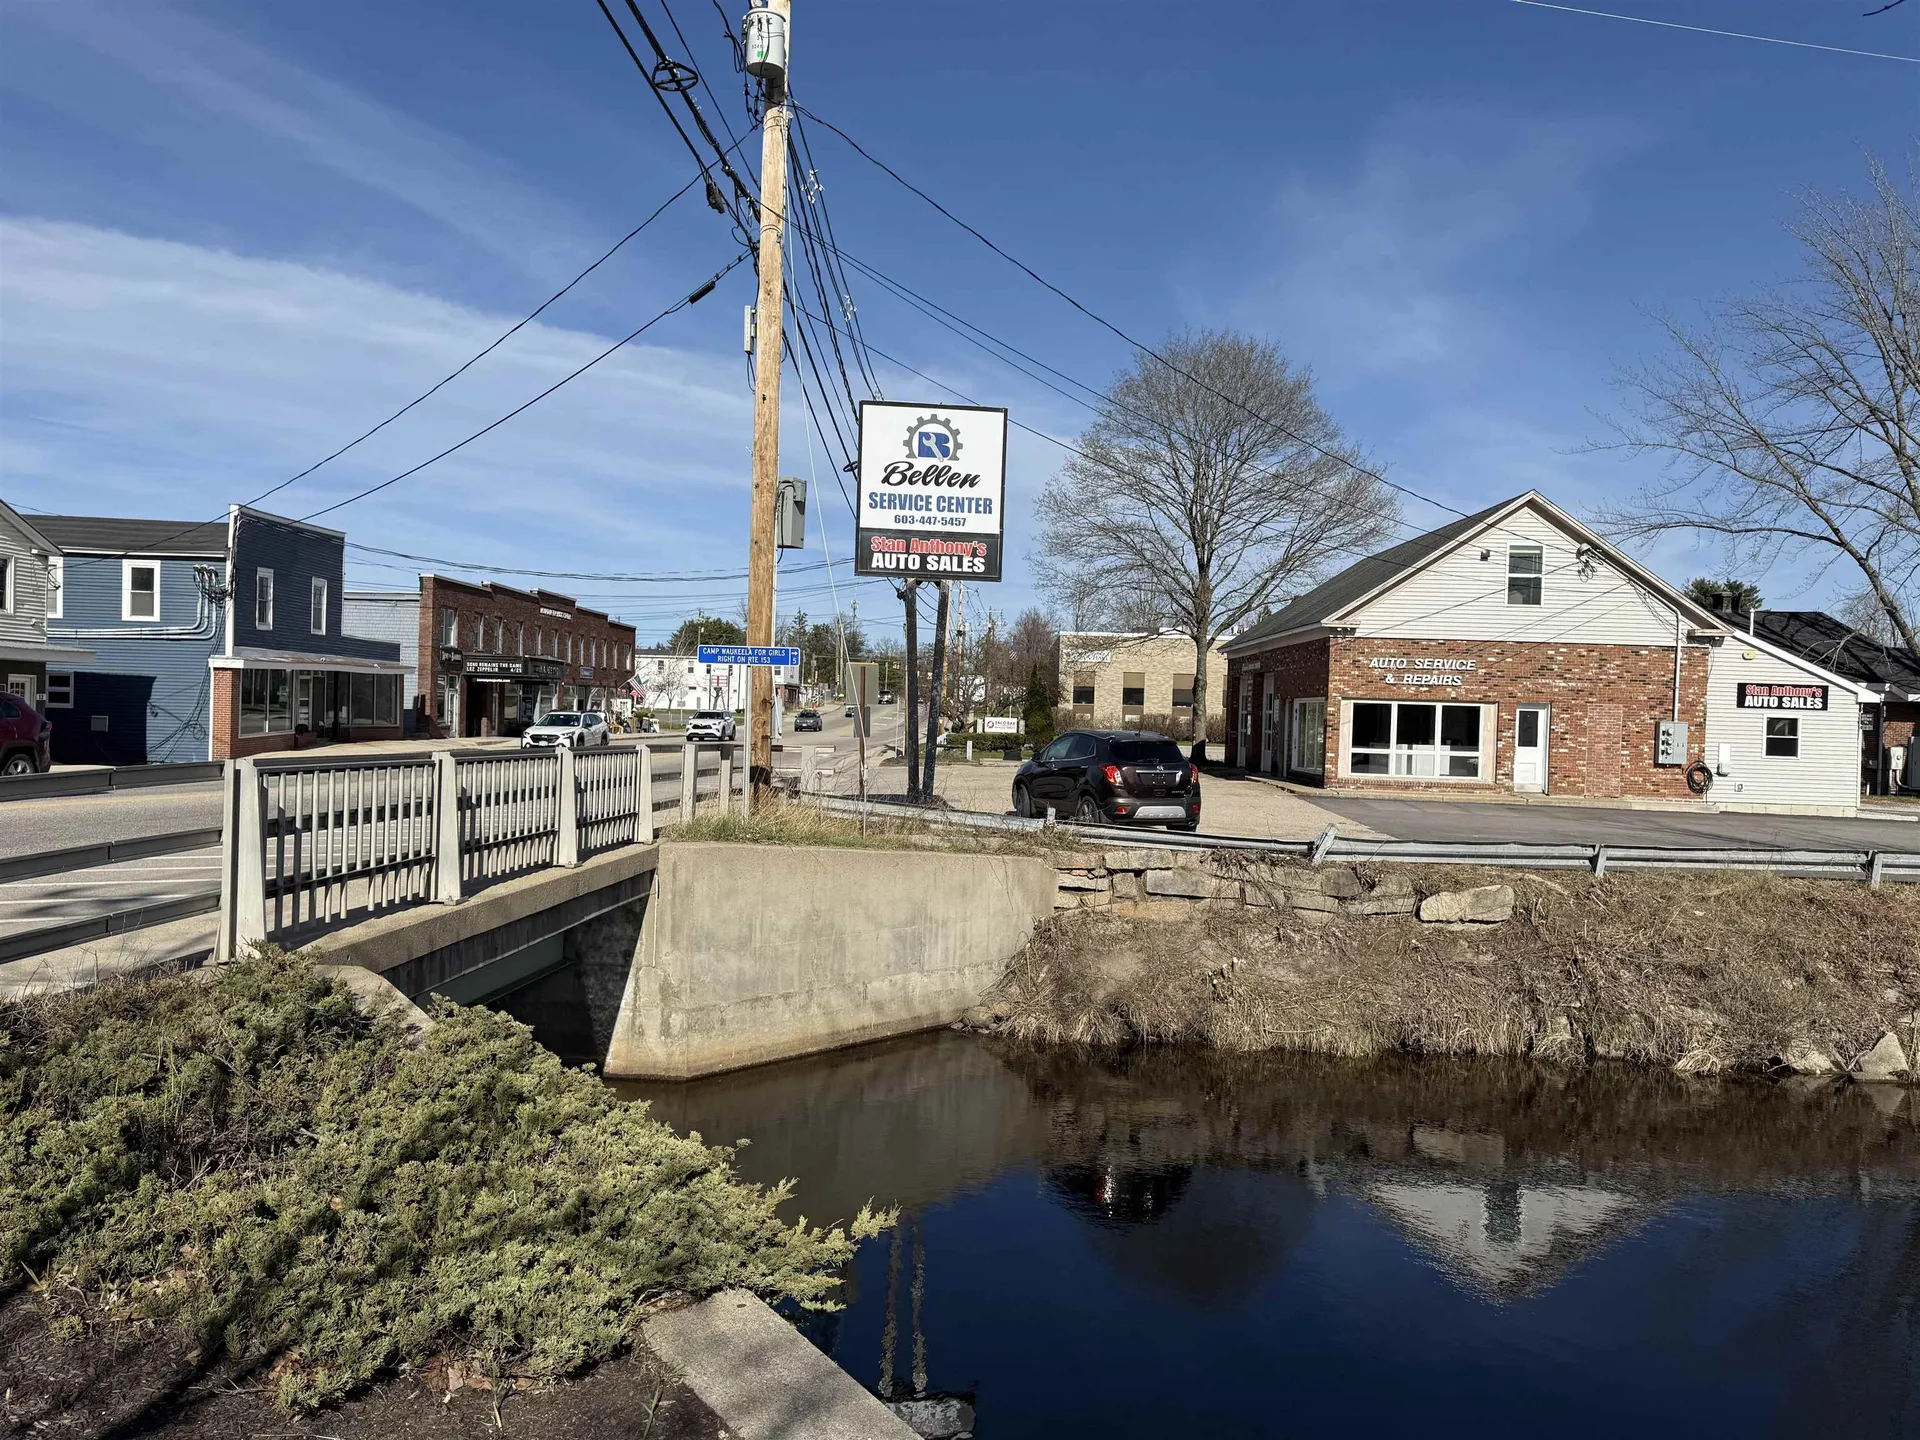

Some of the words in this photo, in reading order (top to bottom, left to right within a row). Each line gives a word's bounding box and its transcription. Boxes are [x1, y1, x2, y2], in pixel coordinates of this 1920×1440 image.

[881, 461, 982, 489] Bellen
[869, 492, 932, 512] SERVICE
[936, 495, 993, 515] CENTER
[871, 535, 906, 552] Stan
[910, 537, 987, 557] Anthony's
[871, 553, 920, 570] AUTO
[926, 556, 986, 573] SALES
[702, 647, 720, 655] CAMP
[721, 648, 753, 656] WAUKEELA
[768, 649, 786, 657] GIRLS
[717, 655, 735, 663] RIGHT
[747, 656, 759, 664] RTE
[760, 656, 771, 664] 153
[1369, 657, 1407, 669] AUTO
[1414, 658, 1477, 670] SERVICE
[1384, 673, 1395, 684] &
[1403, 673, 1462, 686] REPAIRS
[1745, 684, 1769, 696] Stan
[1770, 685, 1823, 698] Anthony's
[1744, 695, 1778, 708] AUTO
[1781, 696, 1823, 709] SALES
